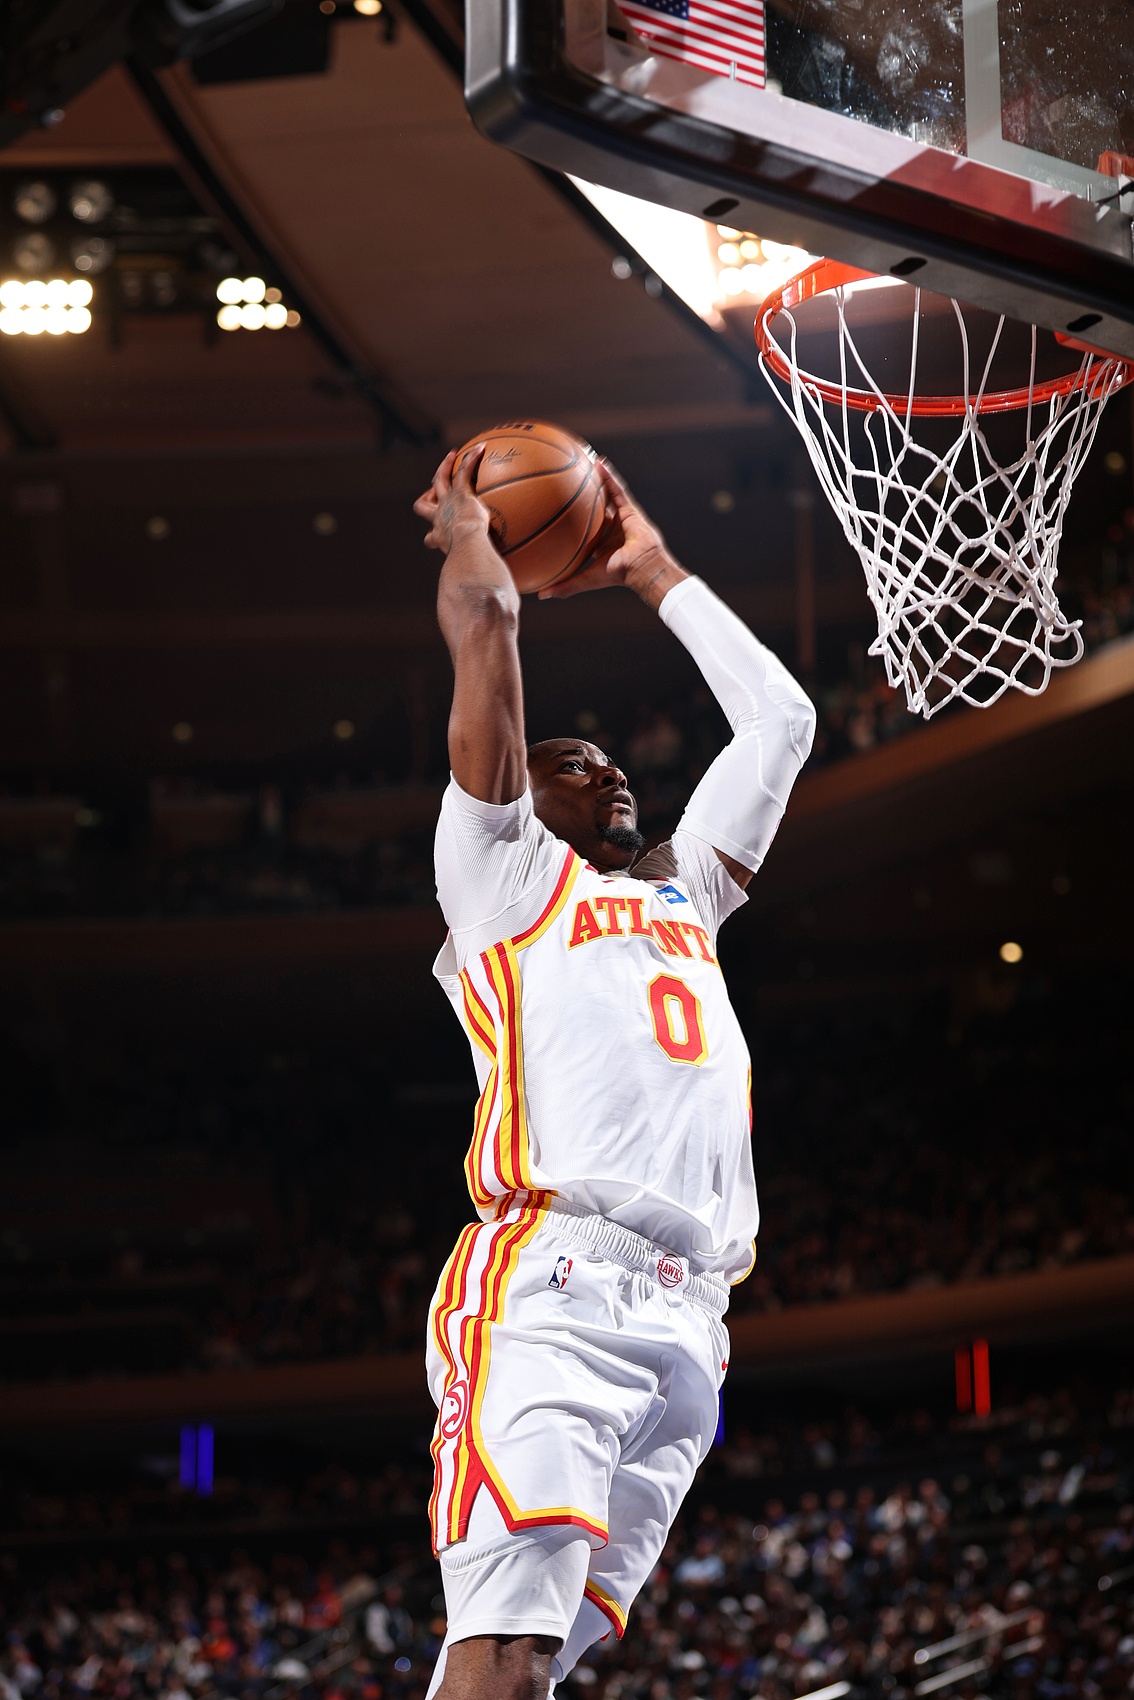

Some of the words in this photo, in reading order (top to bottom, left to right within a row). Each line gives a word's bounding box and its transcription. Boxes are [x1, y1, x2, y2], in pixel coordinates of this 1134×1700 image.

[567, 896, 719, 968] ATLNT
[647, 972, 709, 1067] 0
[656, 1258, 684, 1283] HAWKS
